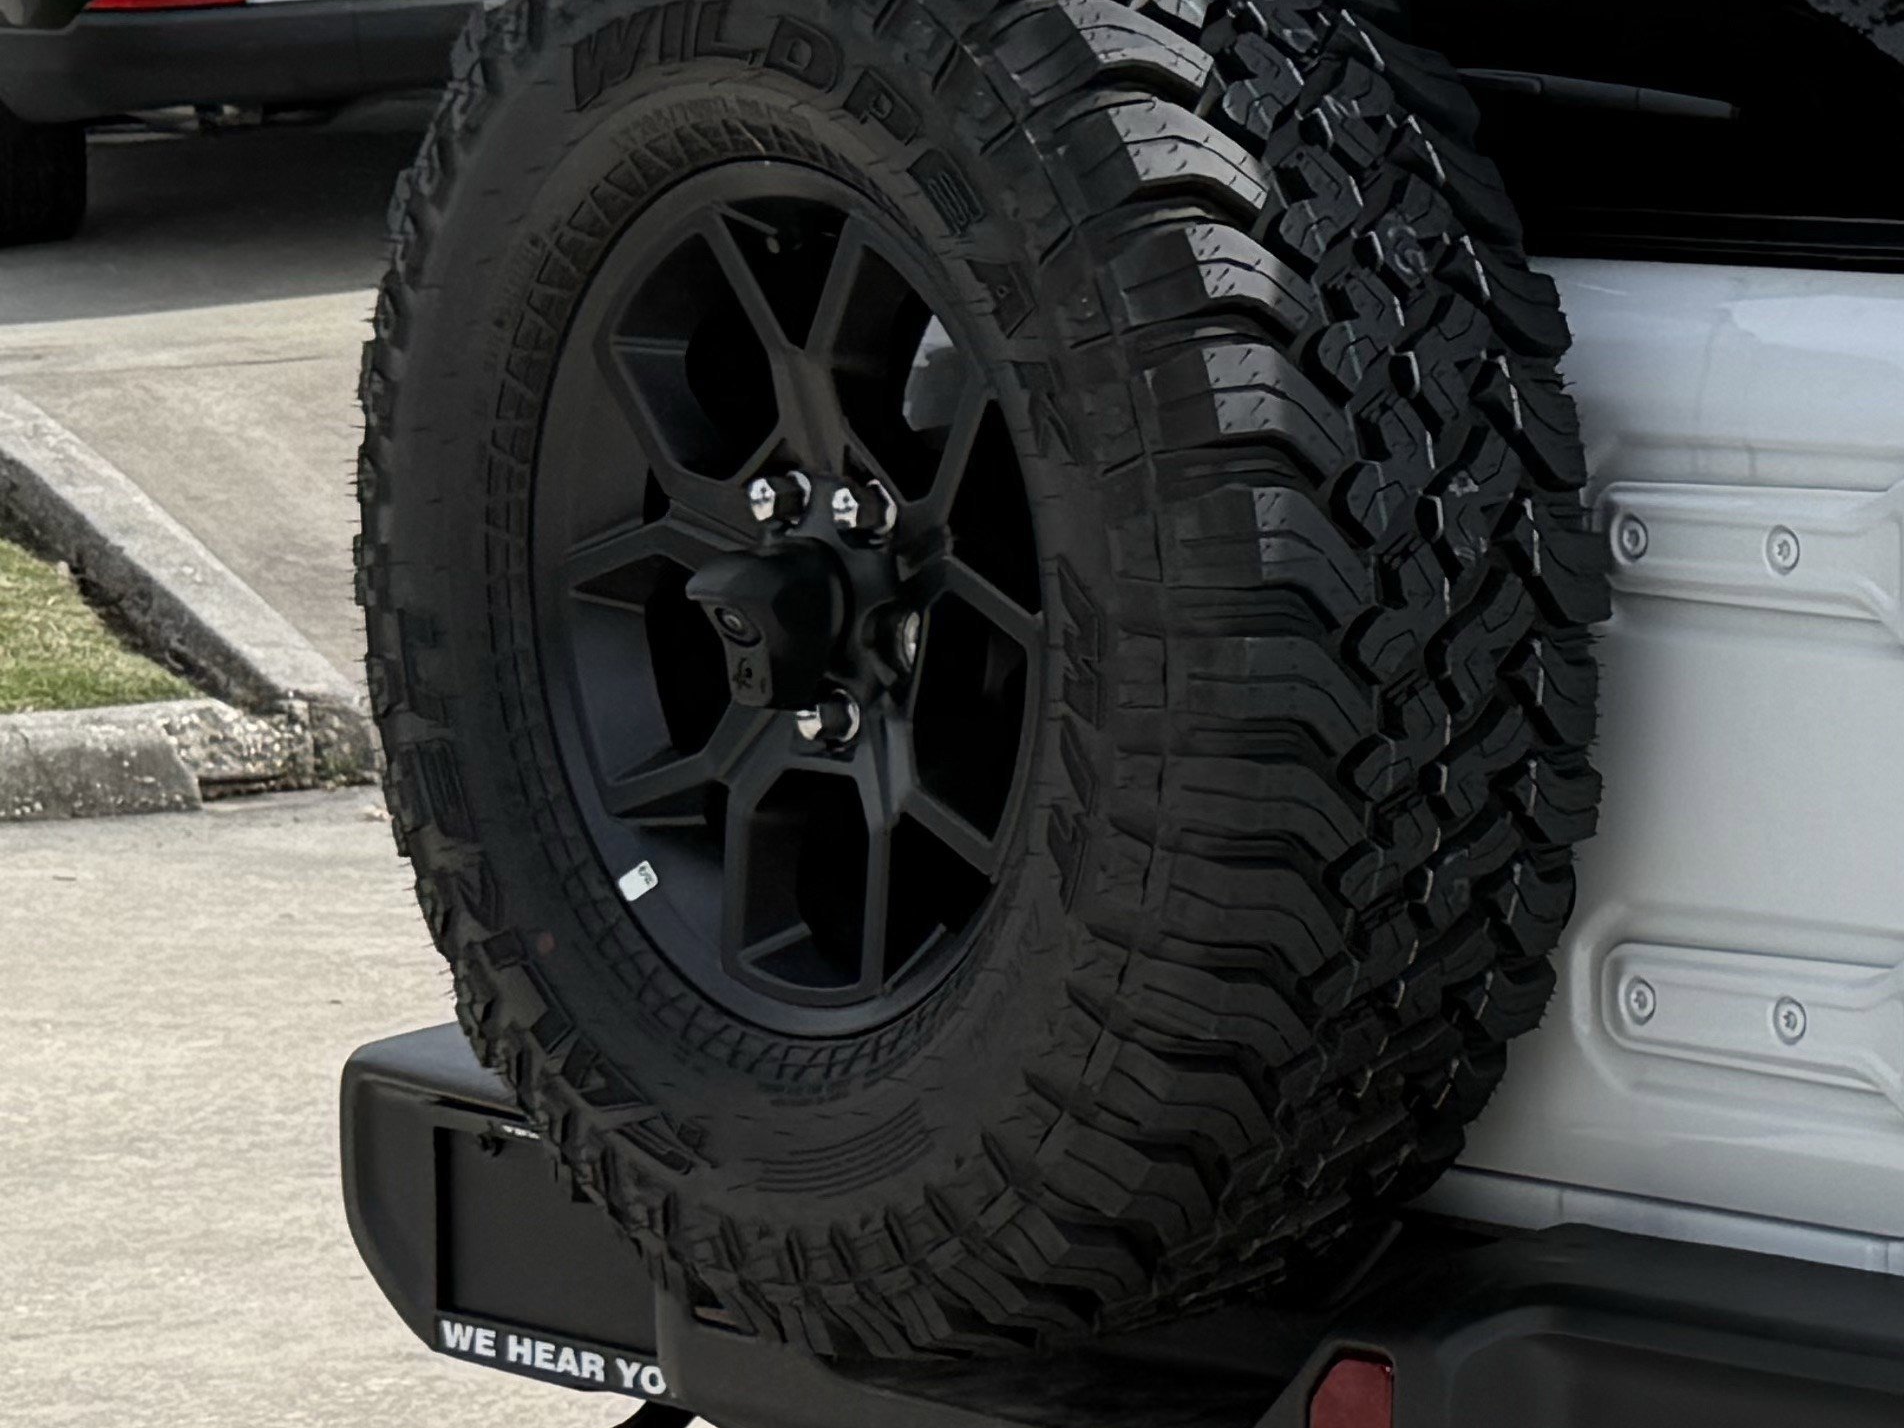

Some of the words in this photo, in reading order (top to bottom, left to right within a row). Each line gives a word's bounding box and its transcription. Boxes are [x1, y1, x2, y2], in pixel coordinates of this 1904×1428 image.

[440, 1320, 497, 1358] WE
[506, 1333, 606, 1383] HEAR
[614, 1357, 669, 1395] YO
